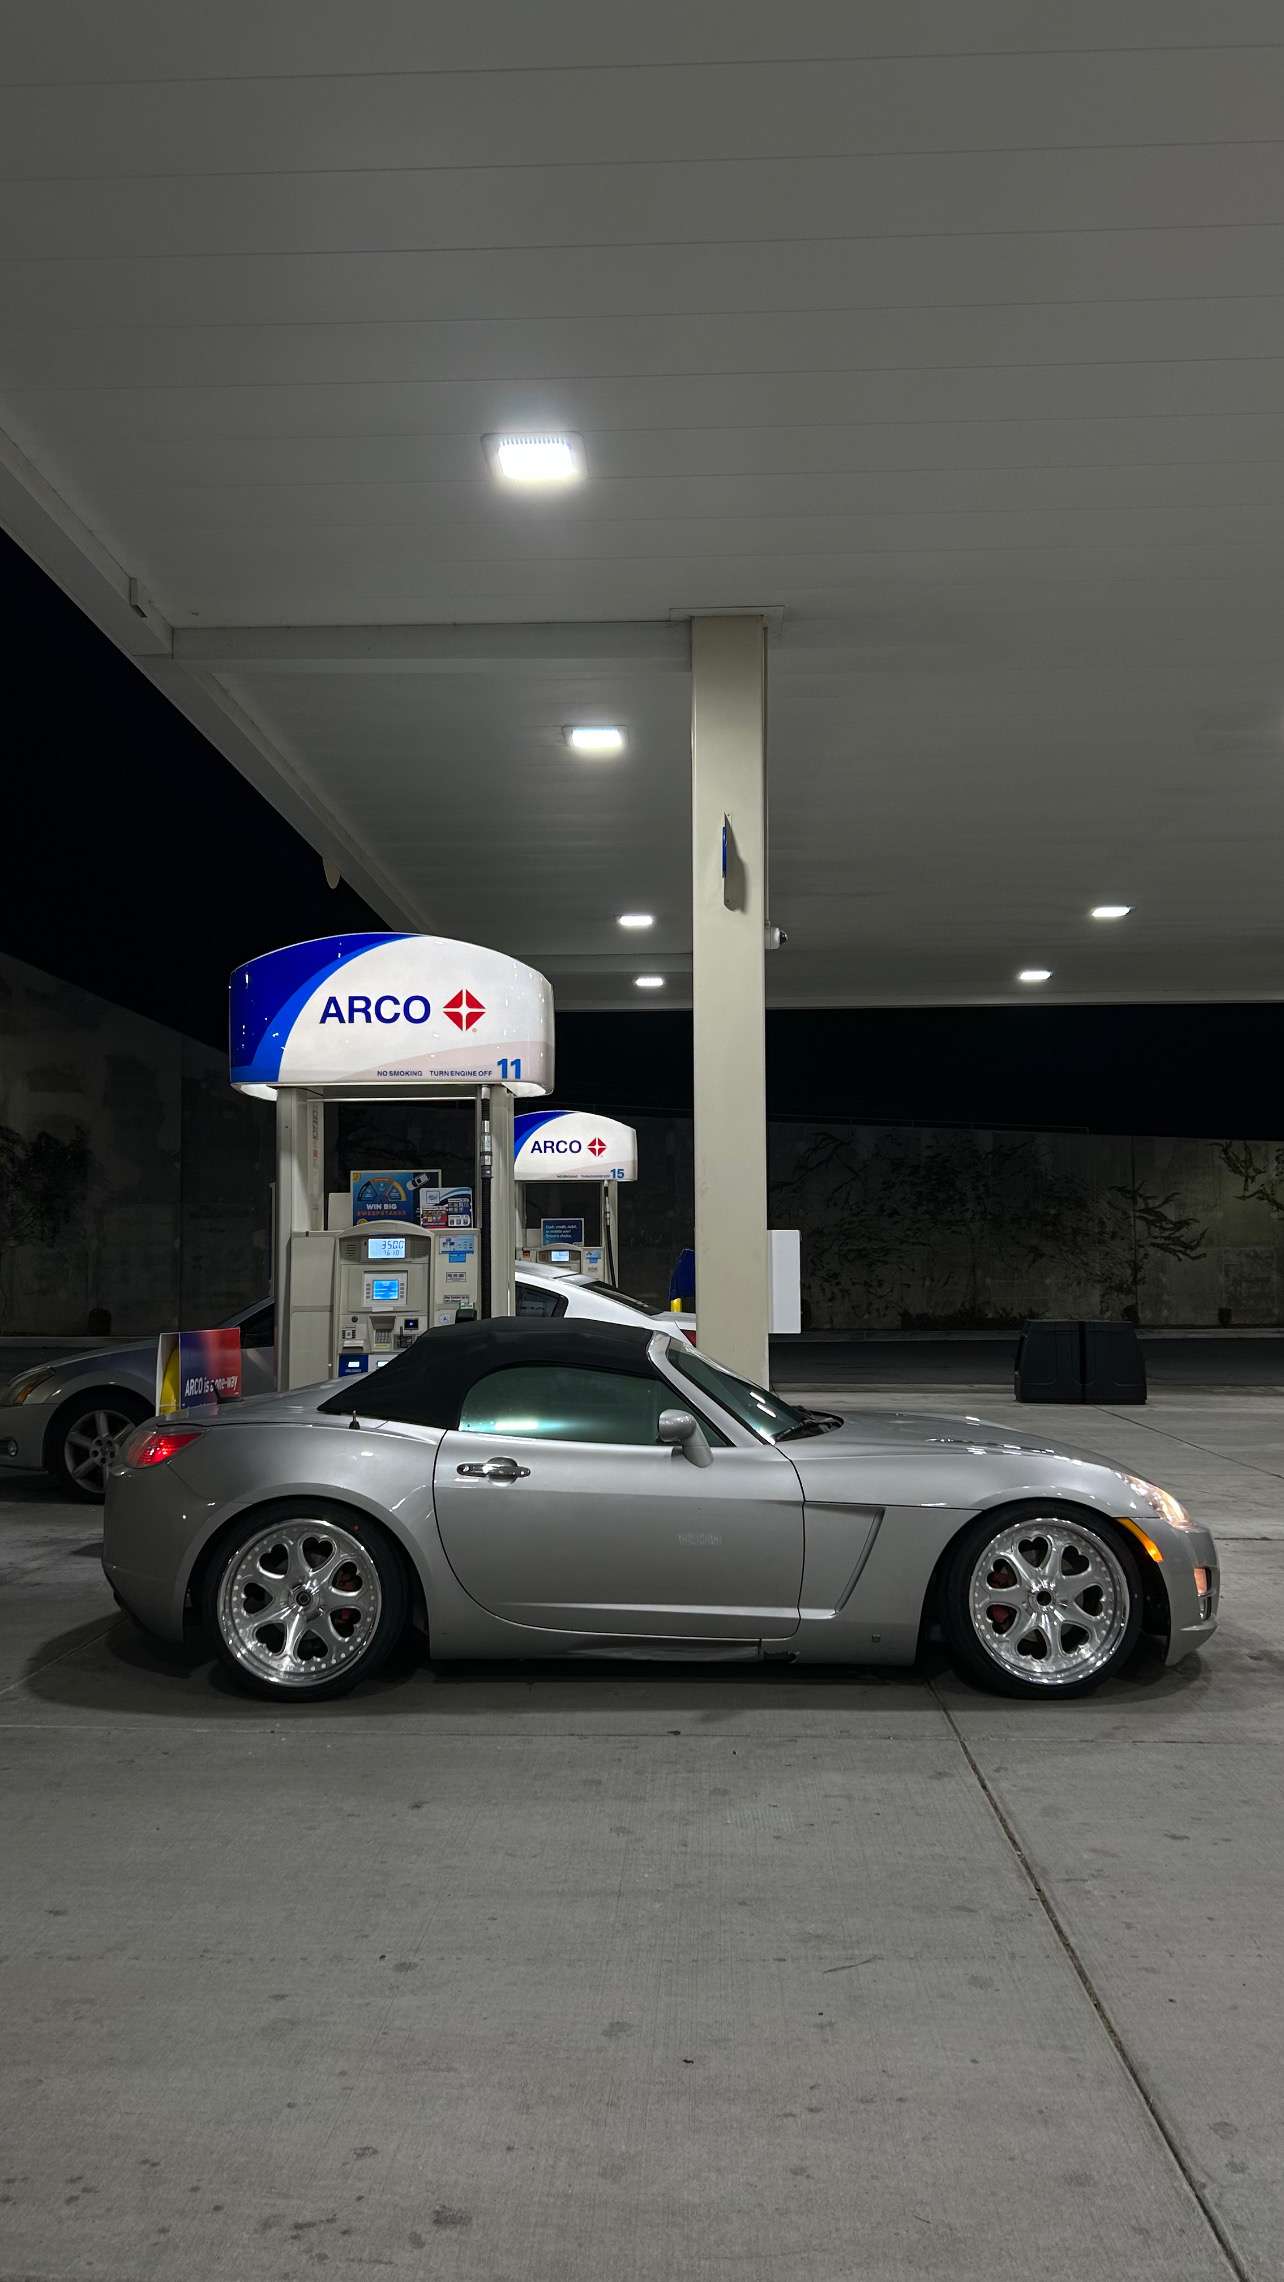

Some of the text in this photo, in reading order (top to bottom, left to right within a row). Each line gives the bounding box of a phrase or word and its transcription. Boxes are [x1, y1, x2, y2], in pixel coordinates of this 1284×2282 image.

[319, 995, 431, 1025] ARCO
[496, 1058, 521, 1080] 11
[530, 1140, 582, 1154] ARCO
[610, 1168, 625, 1179] 15
[185, 1377, 203, 1397] ARCO
[204, 1376, 210, 1393] is
